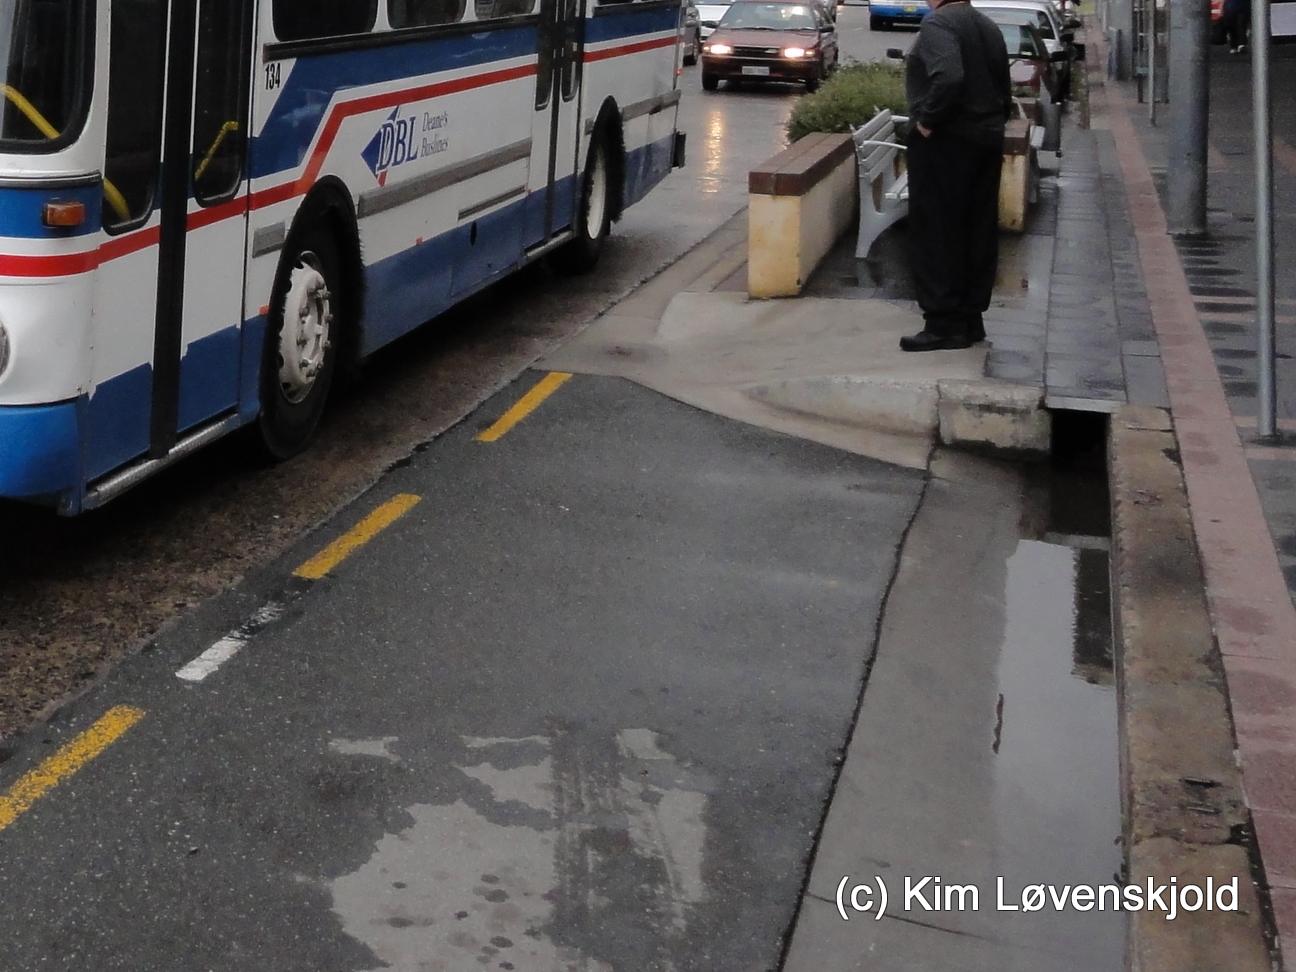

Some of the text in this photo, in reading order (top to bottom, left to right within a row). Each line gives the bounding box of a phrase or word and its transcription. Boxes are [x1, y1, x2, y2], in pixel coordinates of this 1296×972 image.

[265, 63, 281, 90] 134
[422, 110, 448, 132] Deane's
[376, 116, 419, 173] DBL
[421, 133, 448, 158] Buslines
